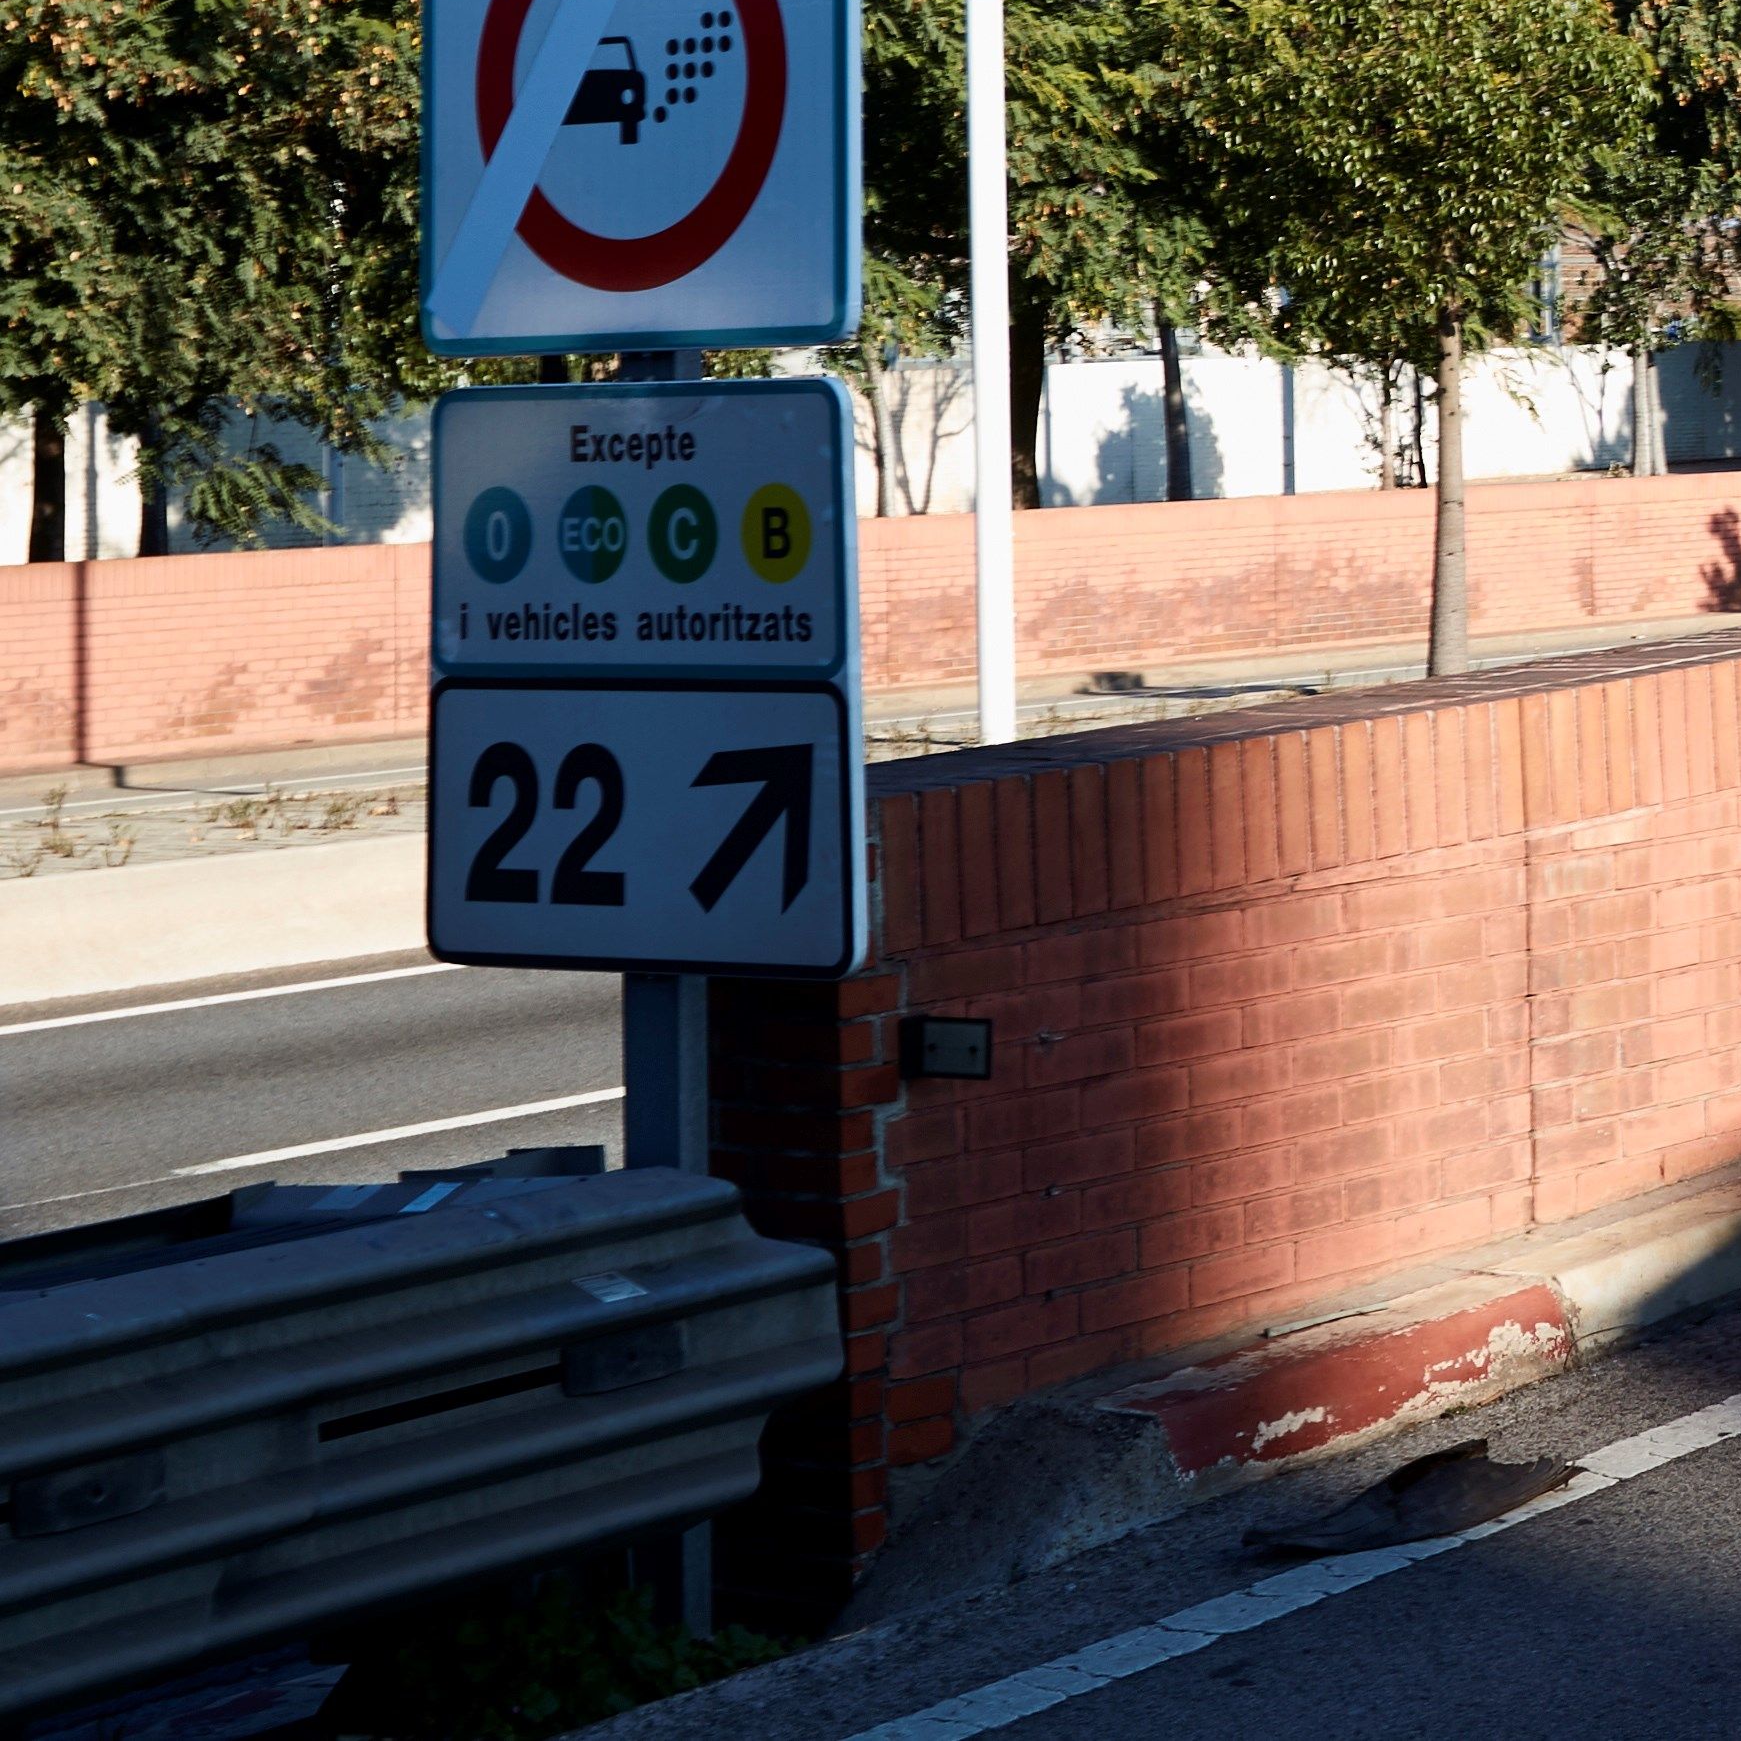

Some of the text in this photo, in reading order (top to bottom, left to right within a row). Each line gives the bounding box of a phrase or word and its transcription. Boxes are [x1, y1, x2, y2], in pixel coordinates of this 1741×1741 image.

[569, 424, 697, 470] Excepte
[563, 517, 625, 553] ECO
[667, 507, 699, 562] C
[762, 506, 792, 560] B
[459, 602, 812, 643] i vehicles autoritzats
[464, 742, 626, 906] 22
